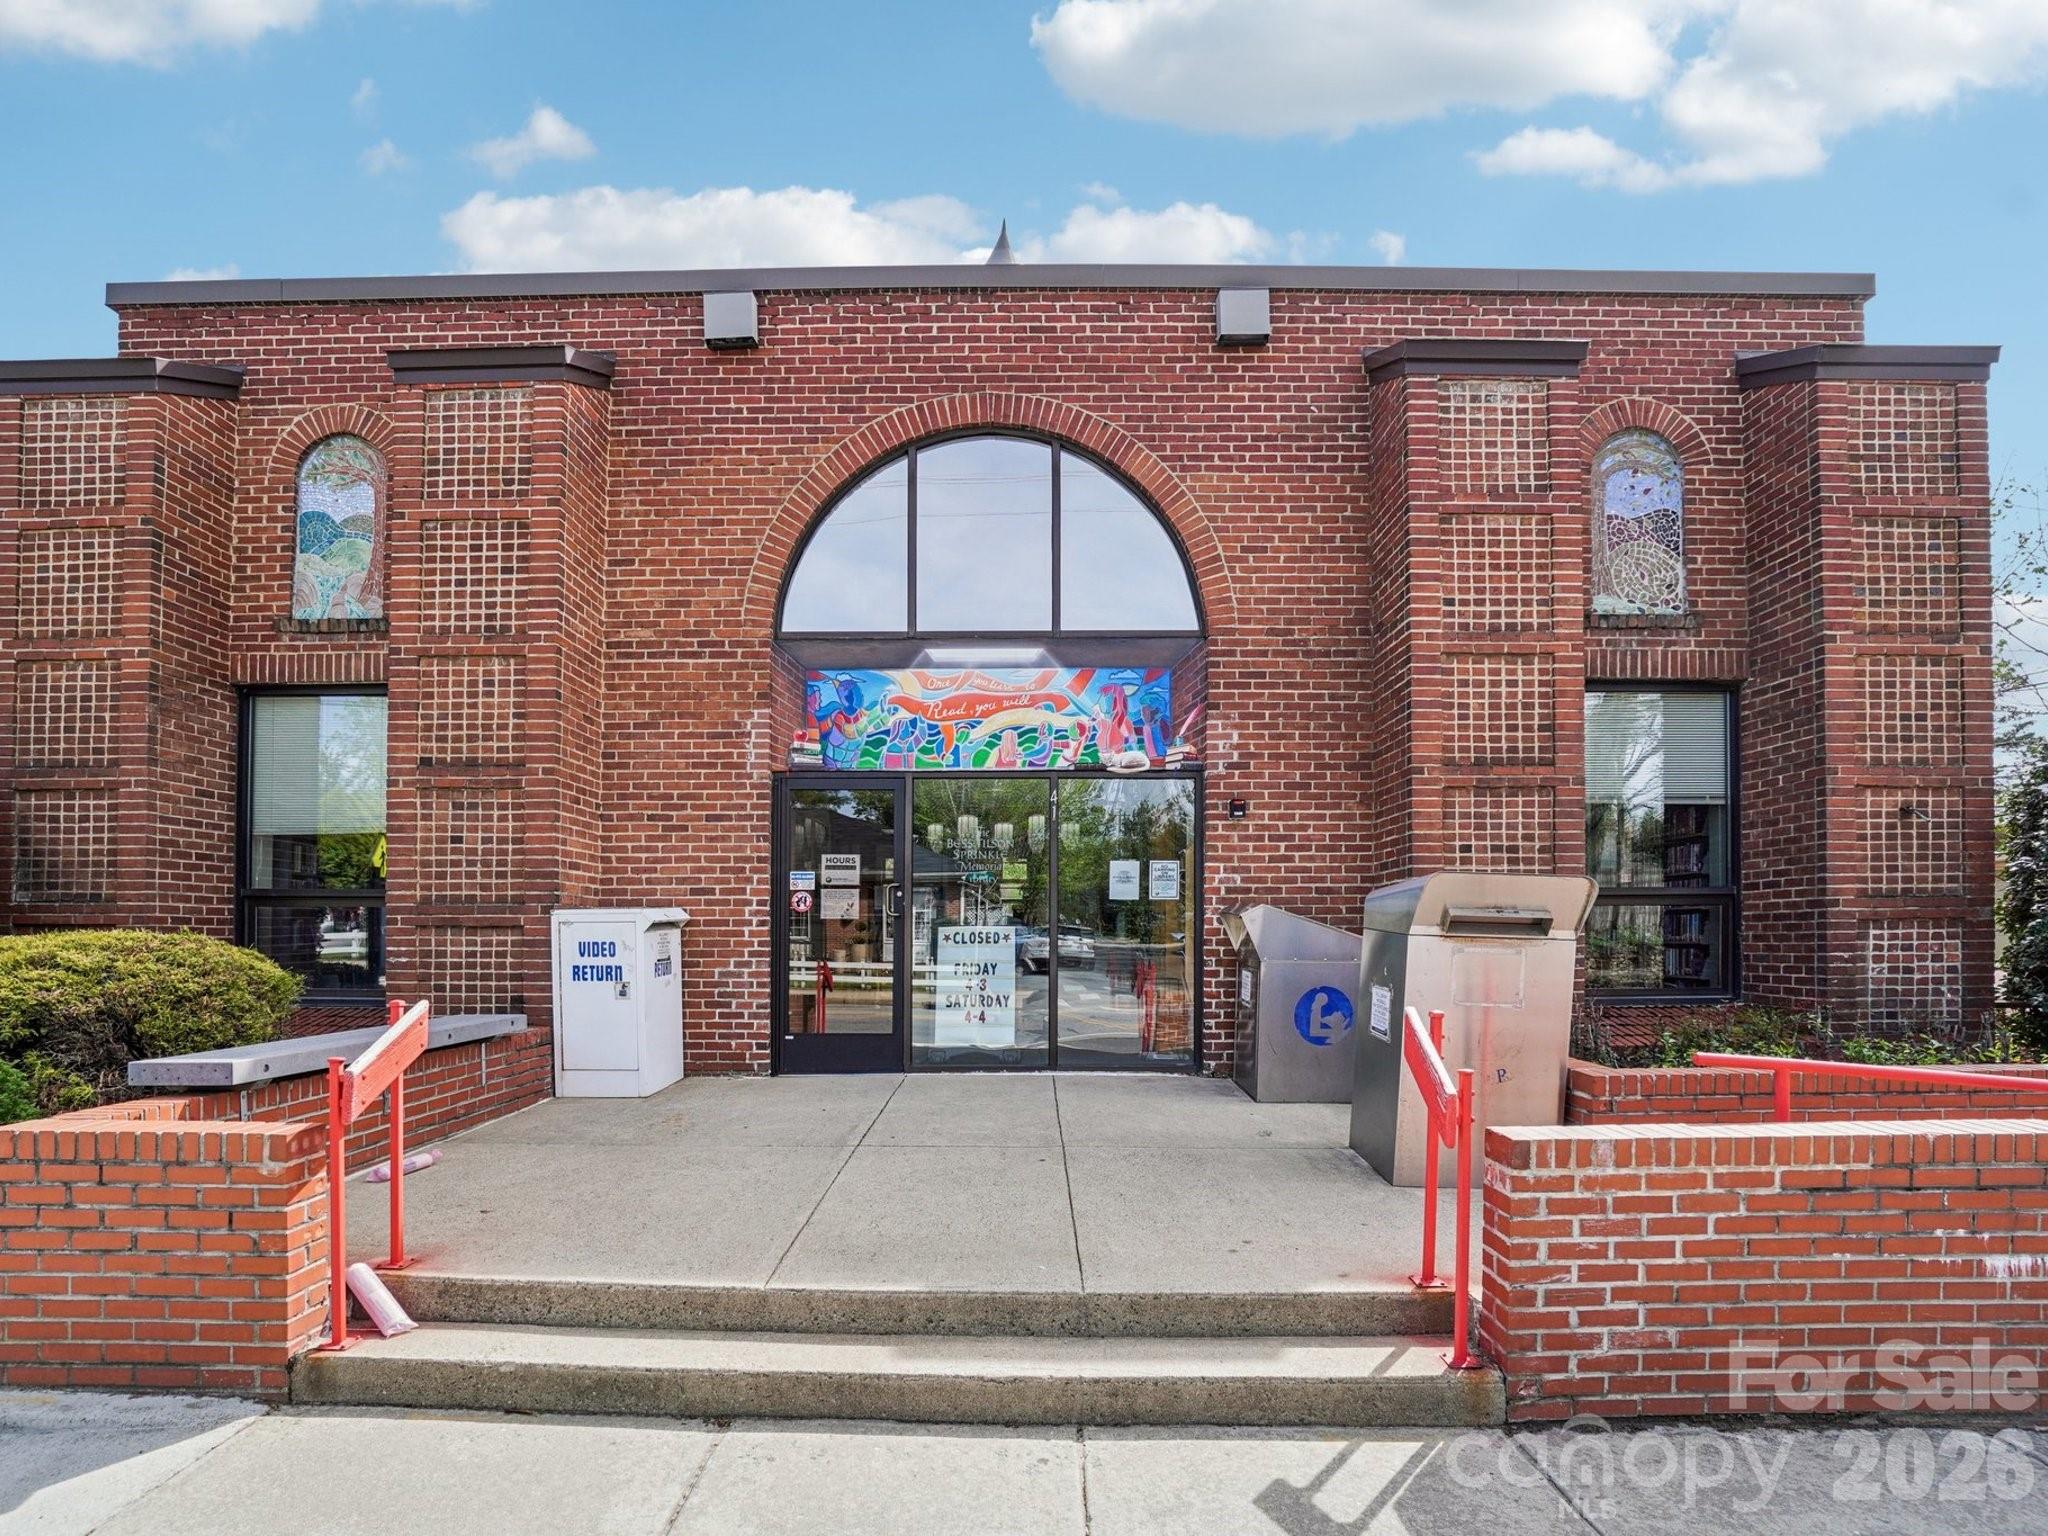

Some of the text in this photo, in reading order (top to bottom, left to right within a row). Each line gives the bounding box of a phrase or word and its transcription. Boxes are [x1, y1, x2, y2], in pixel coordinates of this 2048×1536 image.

[975, 702, 997, 717] you
[1002, 694, 1032, 707] will
[825, 856, 856, 864] HOURS
[953, 931, 1000, 944] CLOSED
[578, 940, 616, 958] VIDEO
[572, 964, 623, 982] RETURN
[954, 962, 998, 976] FRIDAY
[945, 994, 1010, 1008] SATURDAY
[964, 1009, 987, 1024] 4-4
